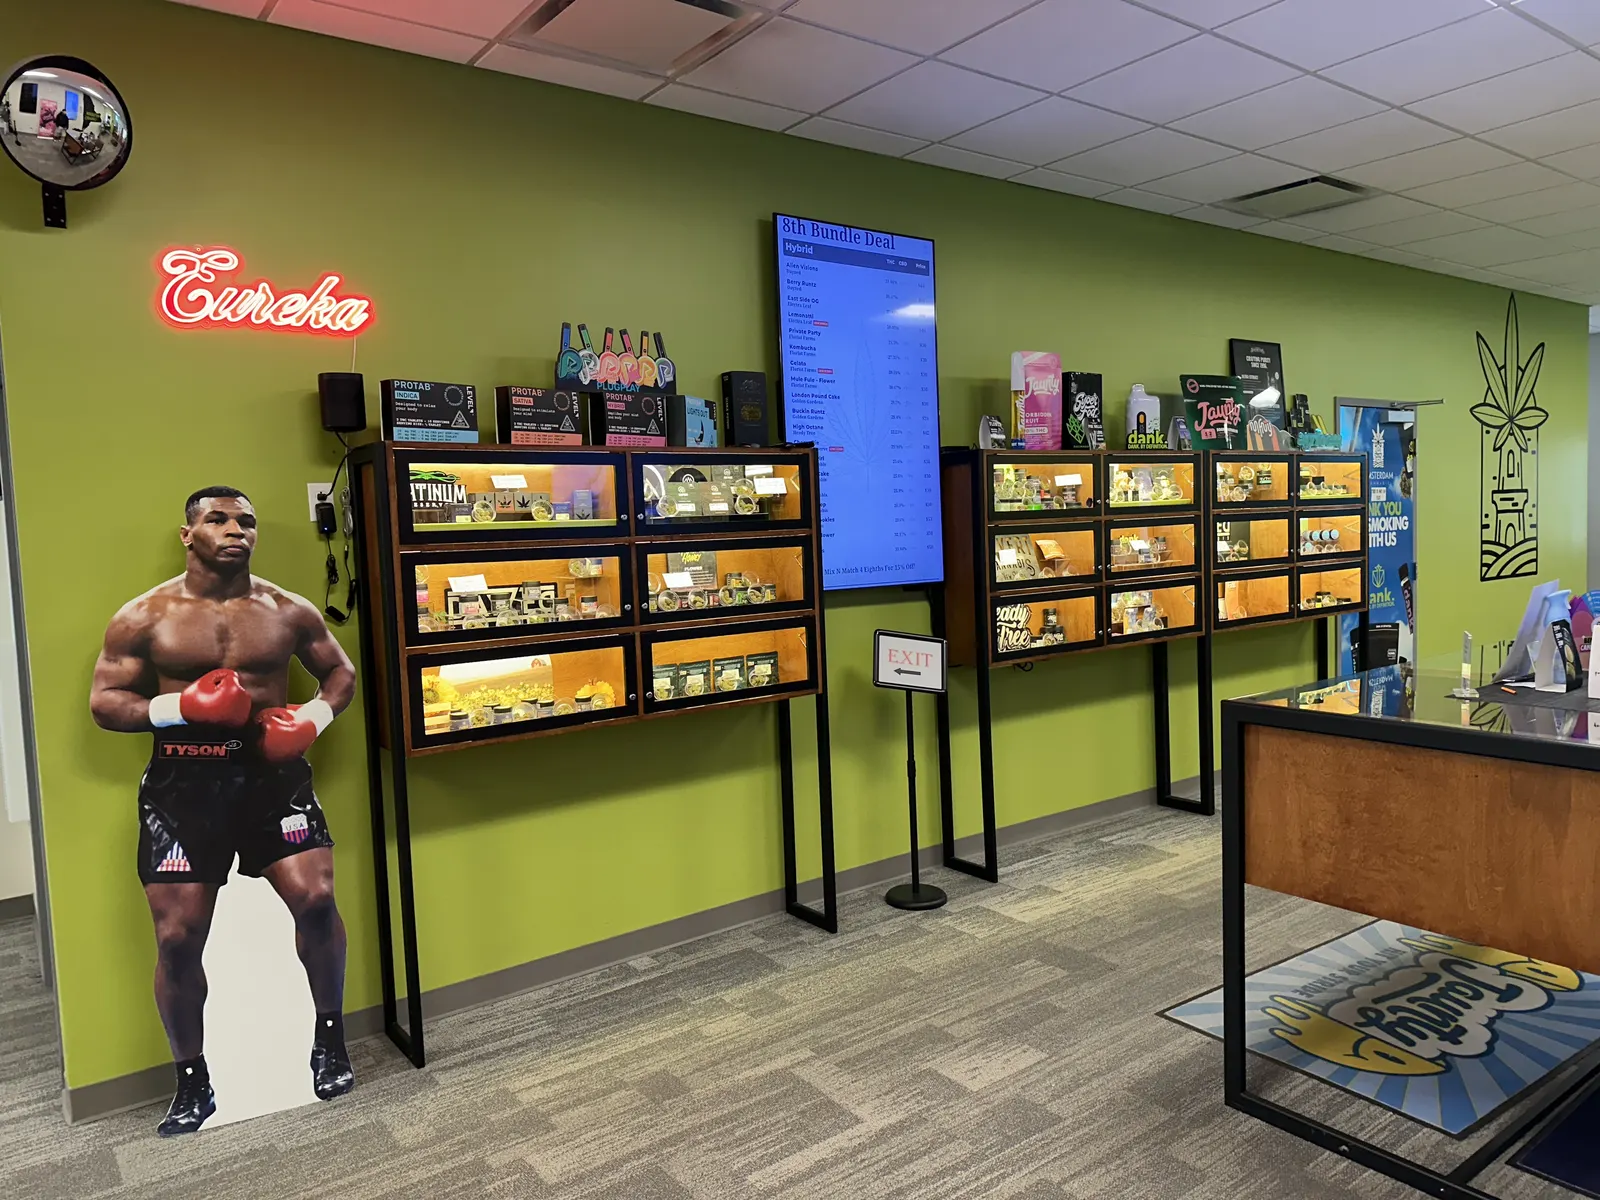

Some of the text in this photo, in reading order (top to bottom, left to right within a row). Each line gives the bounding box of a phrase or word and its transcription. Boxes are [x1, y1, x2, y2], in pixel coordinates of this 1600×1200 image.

[782, 217, 896, 250] 8th Bundle Deal
[785, 242, 814, 254] Hybrid
[162, 250, 369, 332] Eureka
[596, 382, 641, 392] PLUGPLAY
[1023, 374, 1060, 399] Jaunty
[700, 410, 708, 418] OUT
[1194, 398, 1242, 432] Jaunty
[1128, 430, 1168, 444] dank.
[410, 482, 467, 504] ATINUM
[1383, 502, 1402, 516] YOU
[1368, 532, 1397, 548] ITH US
[864, 565, 884, 574] Eighths
[1370, 587, 1394, 604] ank.
[996, 604, 1028, 628] eady
[888, 648, 934, 668] EXIT
[164, 744, 226, 756] TYSON
[285, 822, 305, 832] USA
[1354, 958, 1524, 1046] Jaunty
